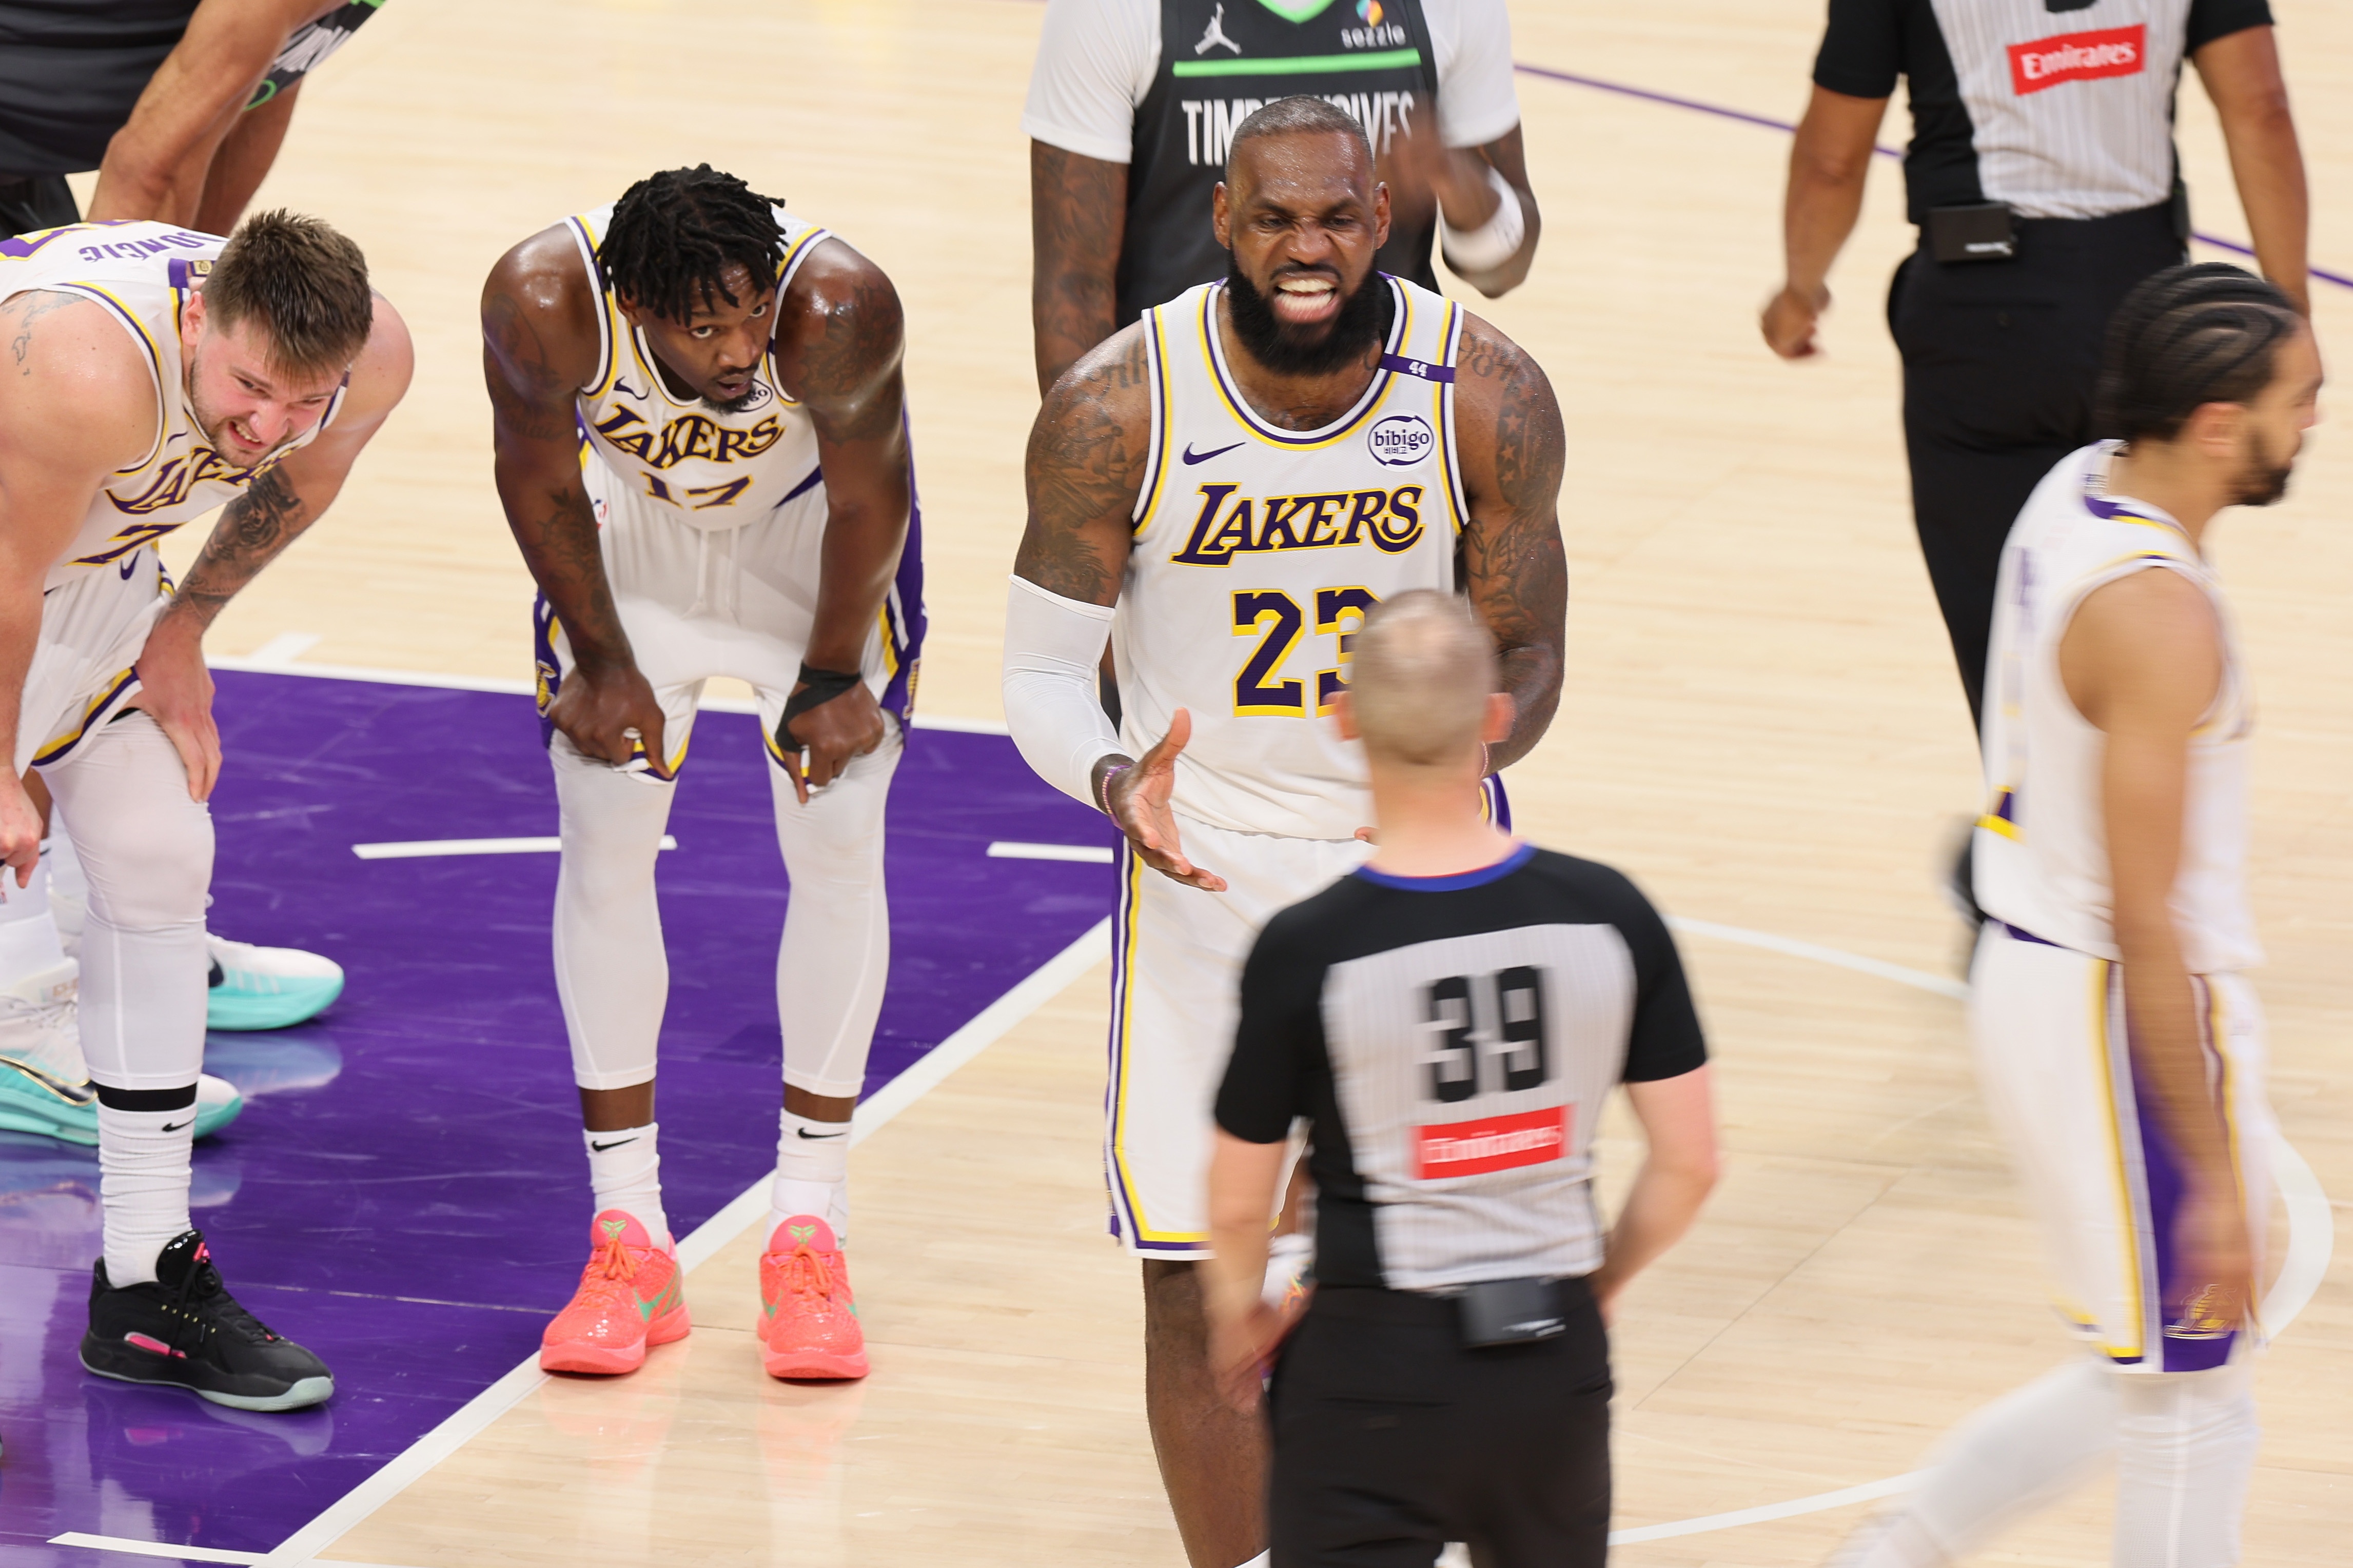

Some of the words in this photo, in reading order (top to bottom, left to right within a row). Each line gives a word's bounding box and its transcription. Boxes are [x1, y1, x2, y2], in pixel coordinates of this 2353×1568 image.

[1409, 361, 1428, 376] 44
[593, 403, 785, 469] LAKERS
[1374, 429, 1429, 450] bibigo
[640, 470, 753, 509] 17
[1169, 482, 1425, 568] LAKERS
[1419, 965, 1552, 1103] 39
